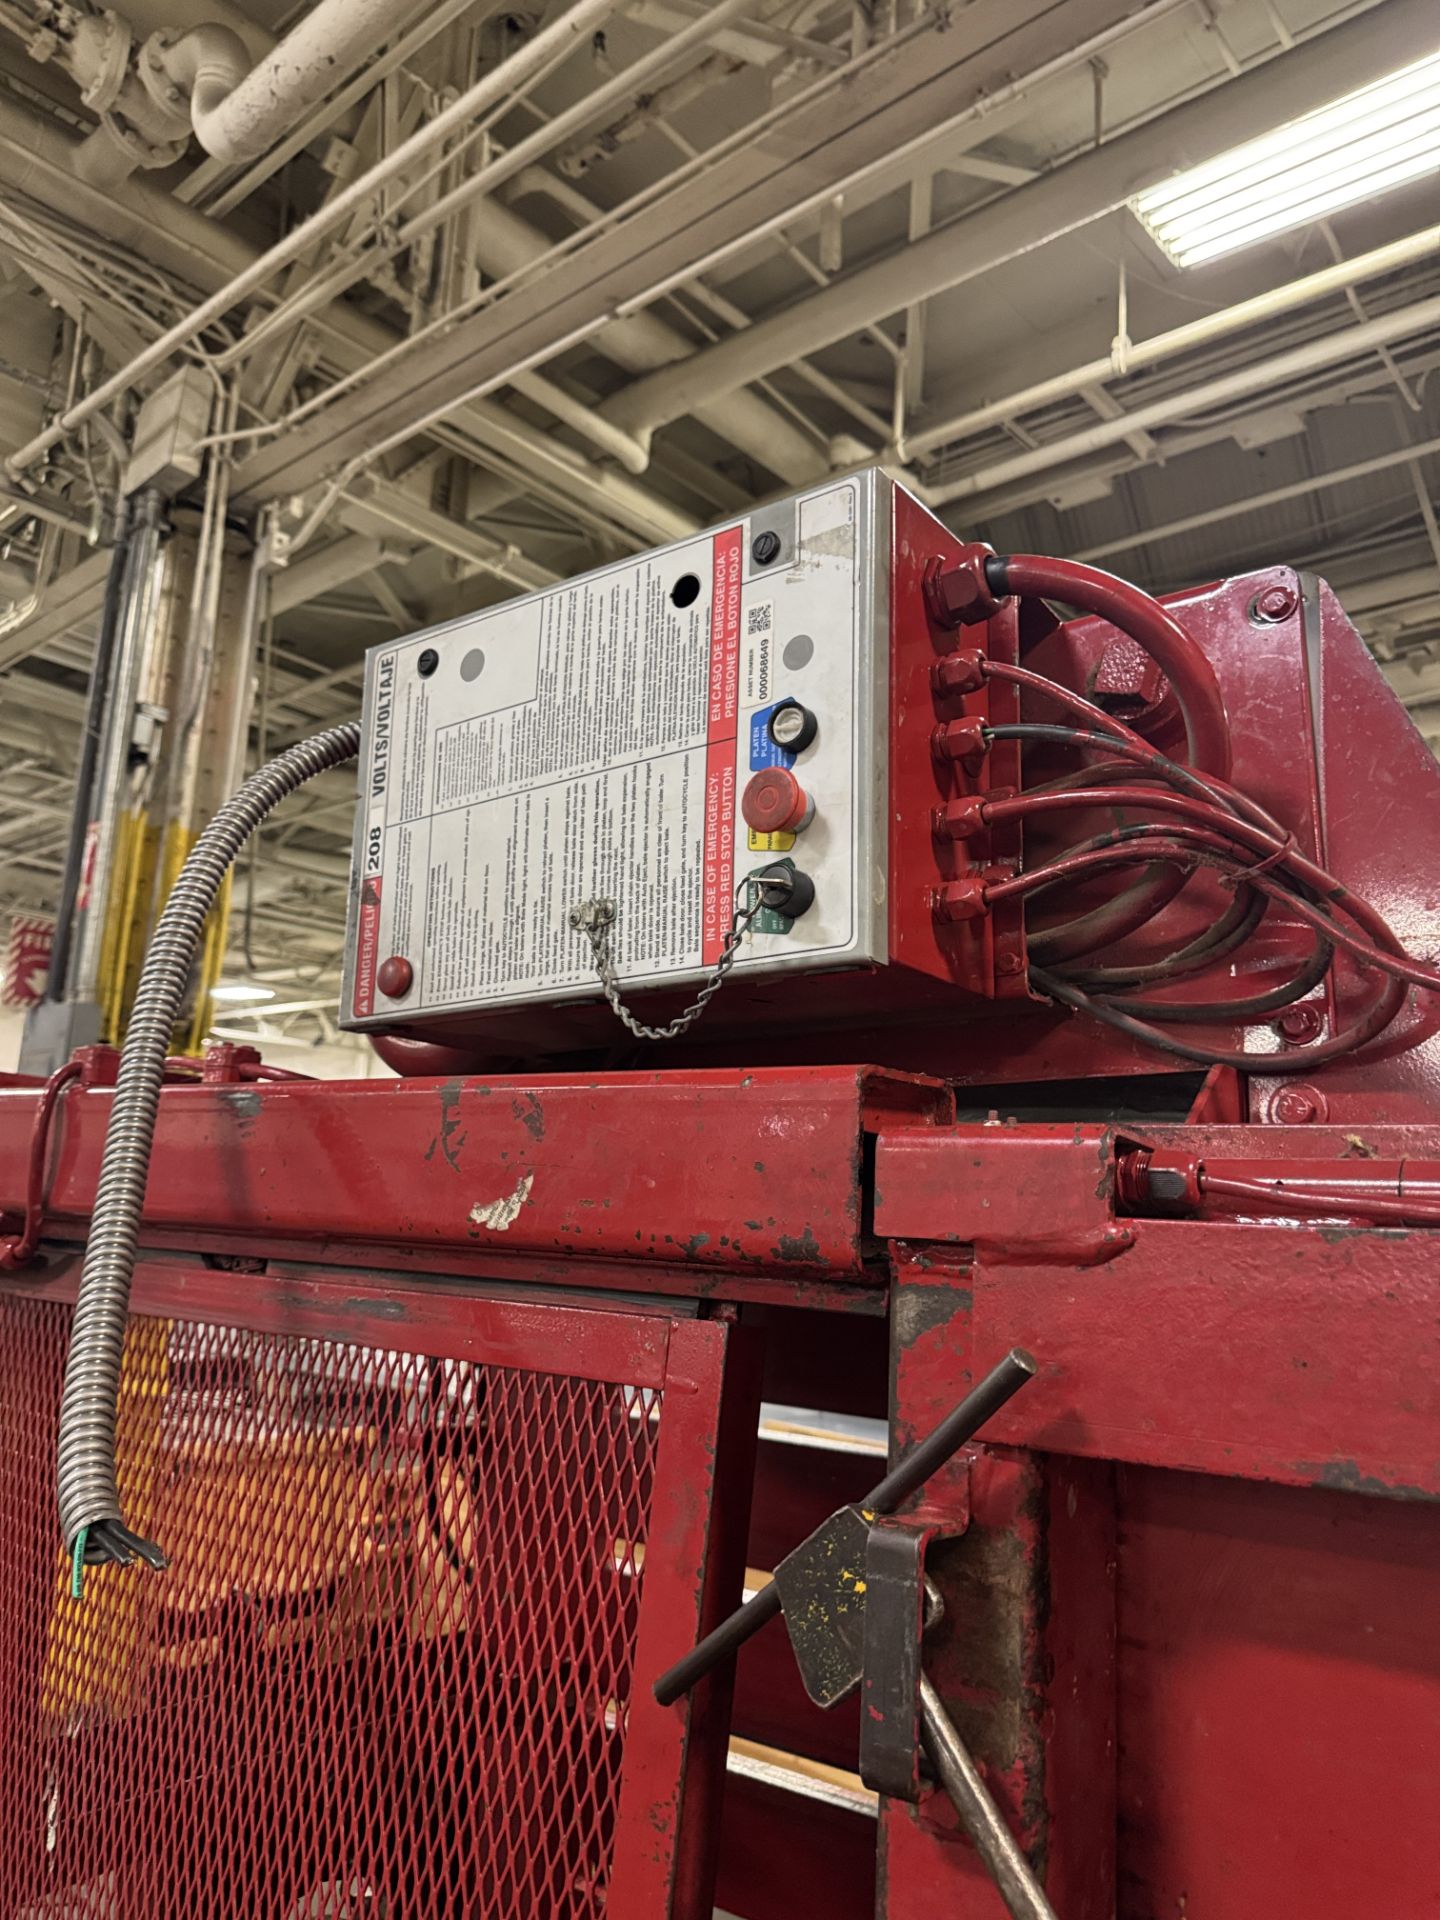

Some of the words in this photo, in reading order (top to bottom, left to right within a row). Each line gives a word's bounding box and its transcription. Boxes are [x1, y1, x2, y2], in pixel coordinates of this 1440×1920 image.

[729, 545, 740, 583] ROJO
[714, 550, 726, 640] EMERGENCIA:
[727, 584, 738, 631] BOTON
[713, 641, 723, 662] DE
[726, 631, 737, 650] EL
[713, 663, 723, 701] CASO
[725, 652, 737, 719] PRESIONE
[758, 638, 770, 701] 000068649
[372, 655, 394, 797] VOLTS/VOLTAJE
[712, 702, 722, 722] EN
[752, 726, 760, 758] PLATEN
[721, 766, 733, 822] BUTTON
[707, 771, 719, 861] EMERGENCY:
[368, 825, 381, 872] 208
[720, 823, 731, 861] STOP
[707, 863, 717, 884] OF
[720, 863, 731, 892] RED
[706, 887, 717, 924] CASE
[720, 895, 730, 941] PRESS
[706, 927, 717, 942] IN
